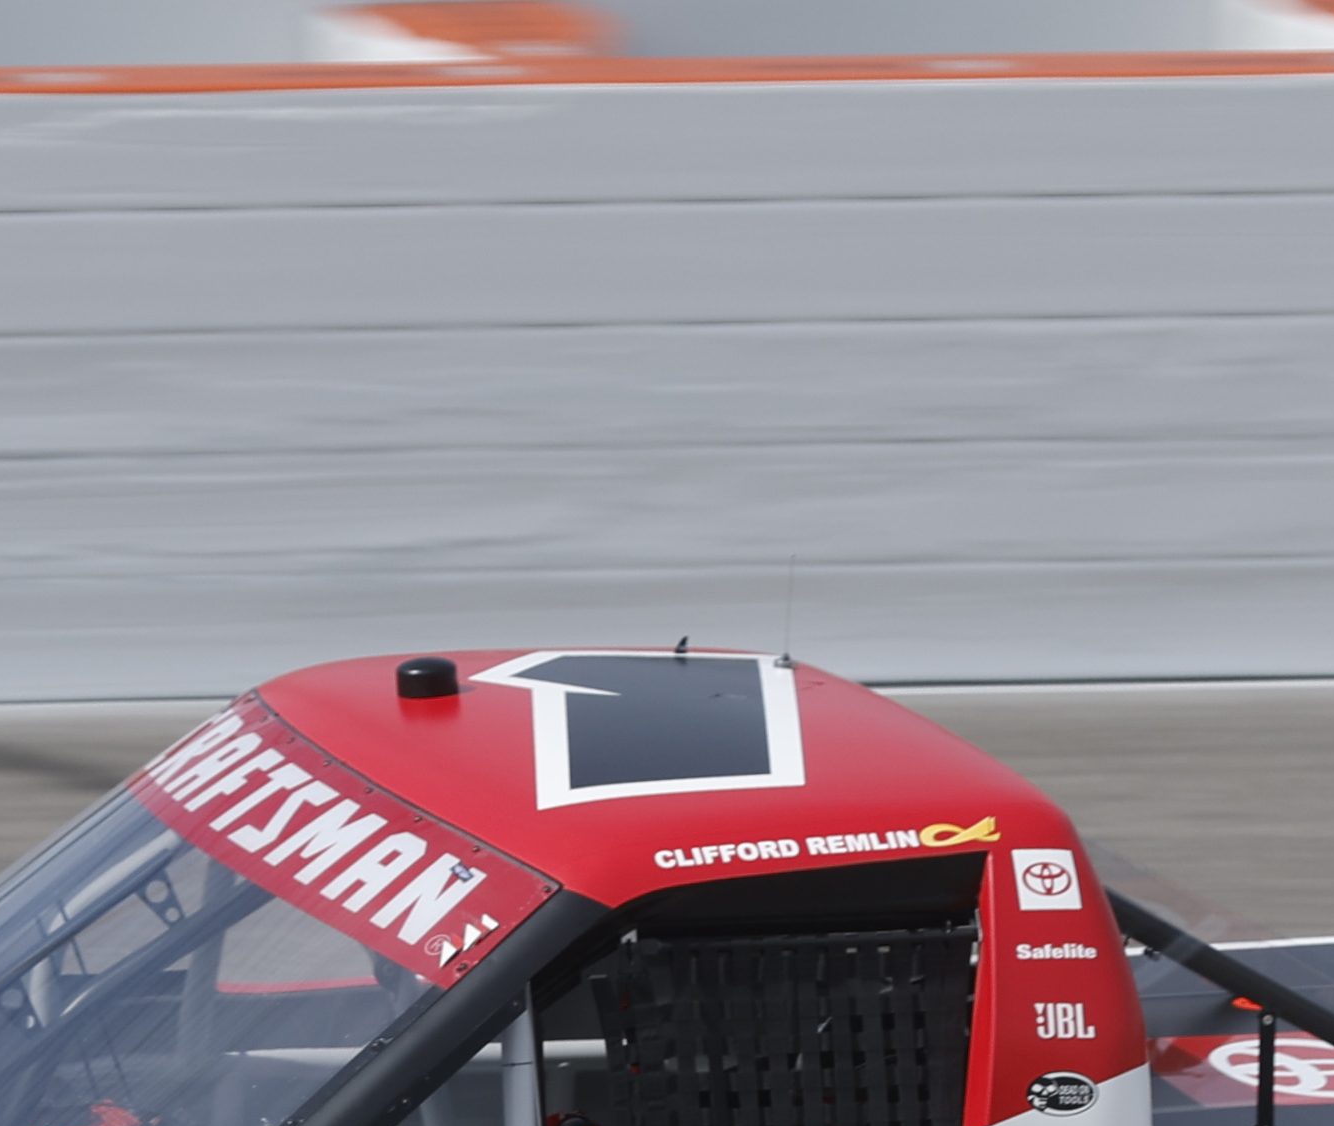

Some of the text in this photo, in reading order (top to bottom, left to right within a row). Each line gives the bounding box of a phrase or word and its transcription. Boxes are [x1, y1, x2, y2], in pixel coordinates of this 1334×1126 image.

[144, 708, 488, 945] RAFTSMAN
[653, 829, 920, 869] CLIFFORD REMLIN
[1015, 943, 1097, 961] Safelite
[1034, 1002, 1095, 1039] JBL
